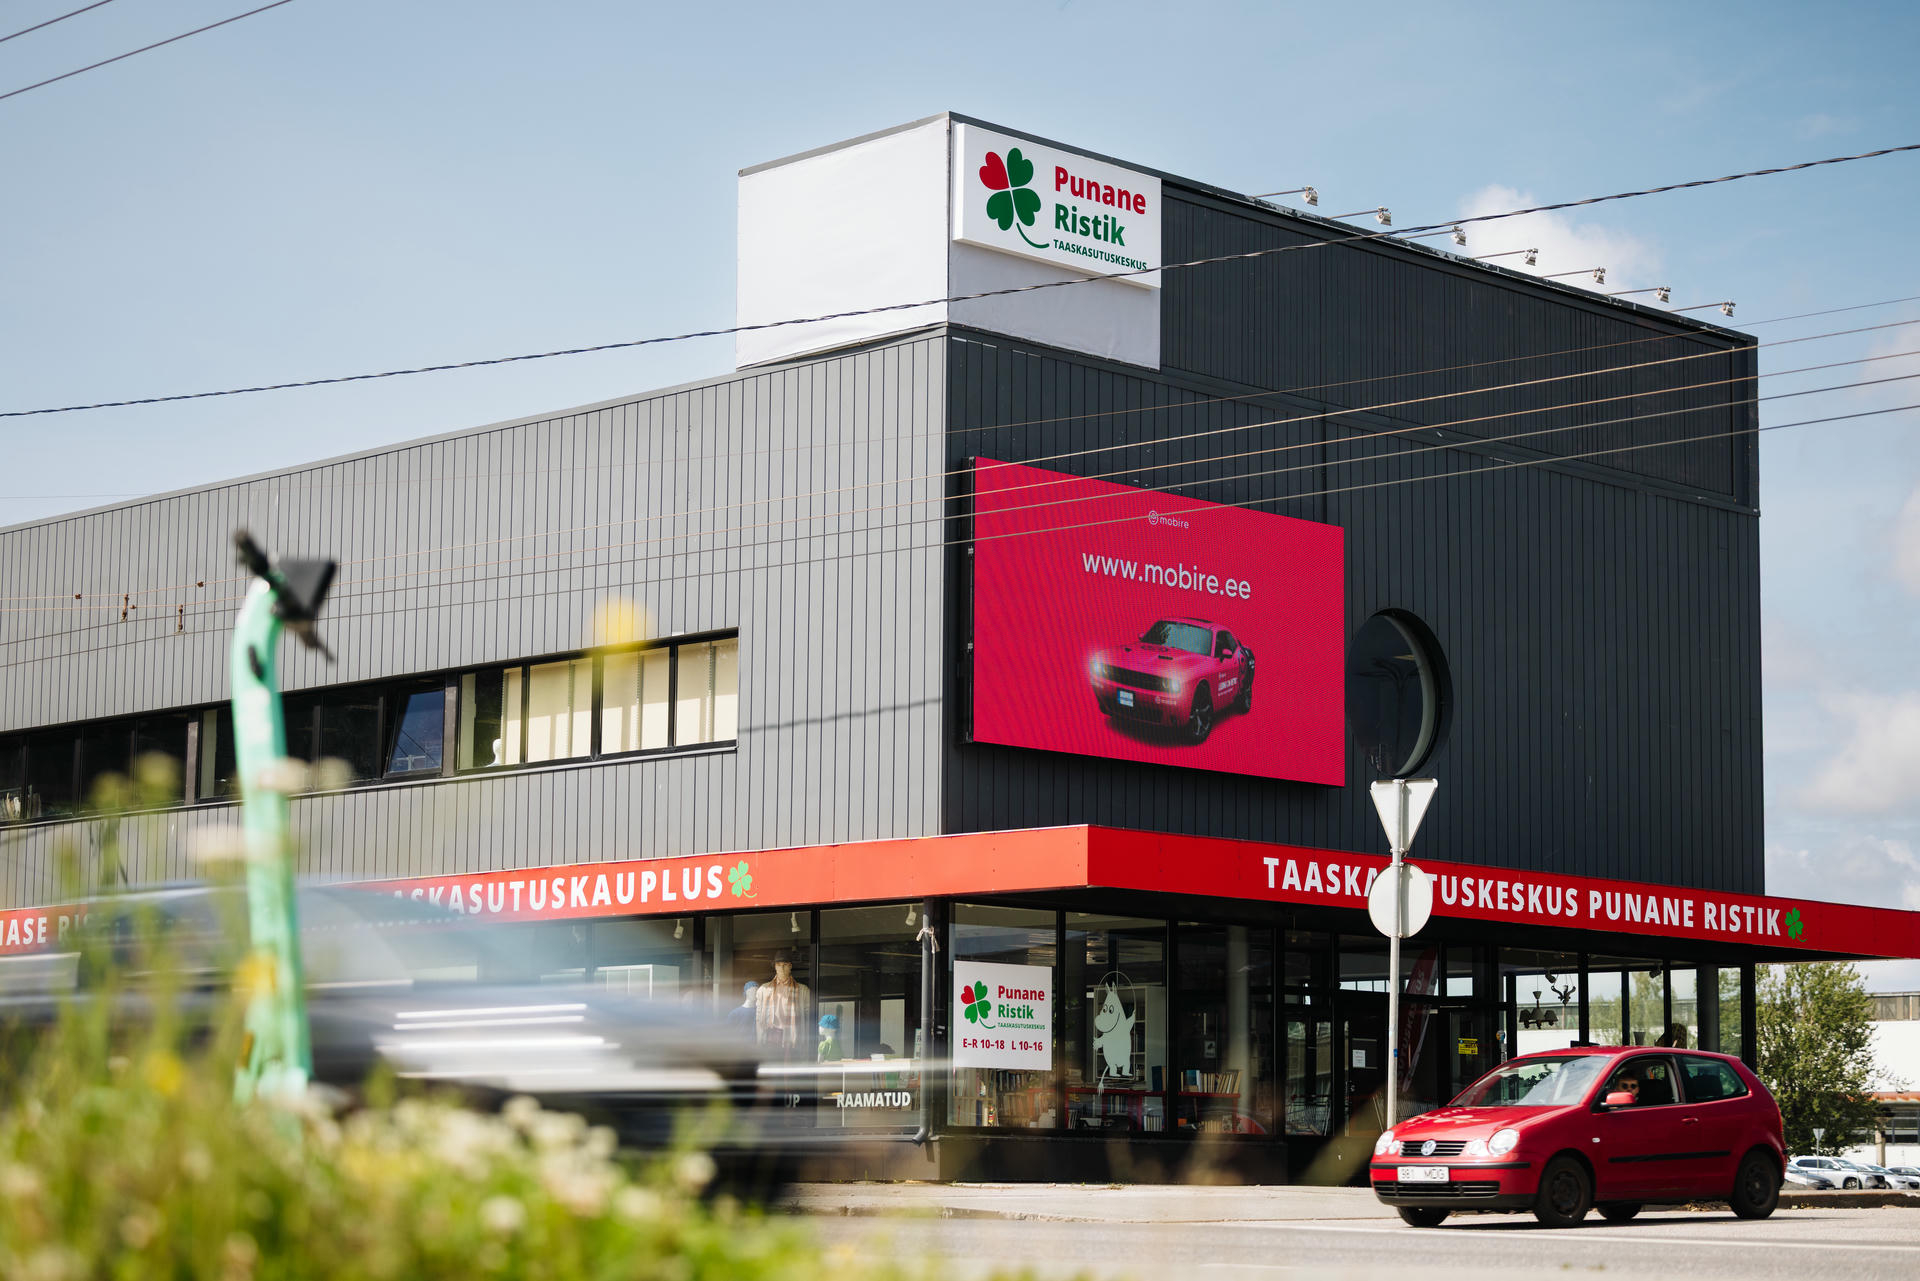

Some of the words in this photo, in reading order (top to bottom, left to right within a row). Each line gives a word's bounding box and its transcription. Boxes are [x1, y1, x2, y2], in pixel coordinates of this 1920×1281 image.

[1055, 165, 1146, 215] Punane
[1055, 203, 1126, 247] Ristik
[1053, 239, 1147, 270] TAASKASUTUSKESKUS
[1160, 516, 1189, 529] mobire
[1082, 552, 1251, 600] www.mobire.ee
[1589, 890, 1694, 928] PUNANE
[1704, 901, 1781, 936] RISTIK
[997, 985, 1045, 1001] Punane
[997, 1004, 1034, 1019] Ristik
[980, 1039, 1005, 1050] 10-18
[1011, 1040, 1017, 1051] L
[1018, 1041, 1043, 1052] 10-16
[836, 1092, 911, 1108] RAAMATUD
